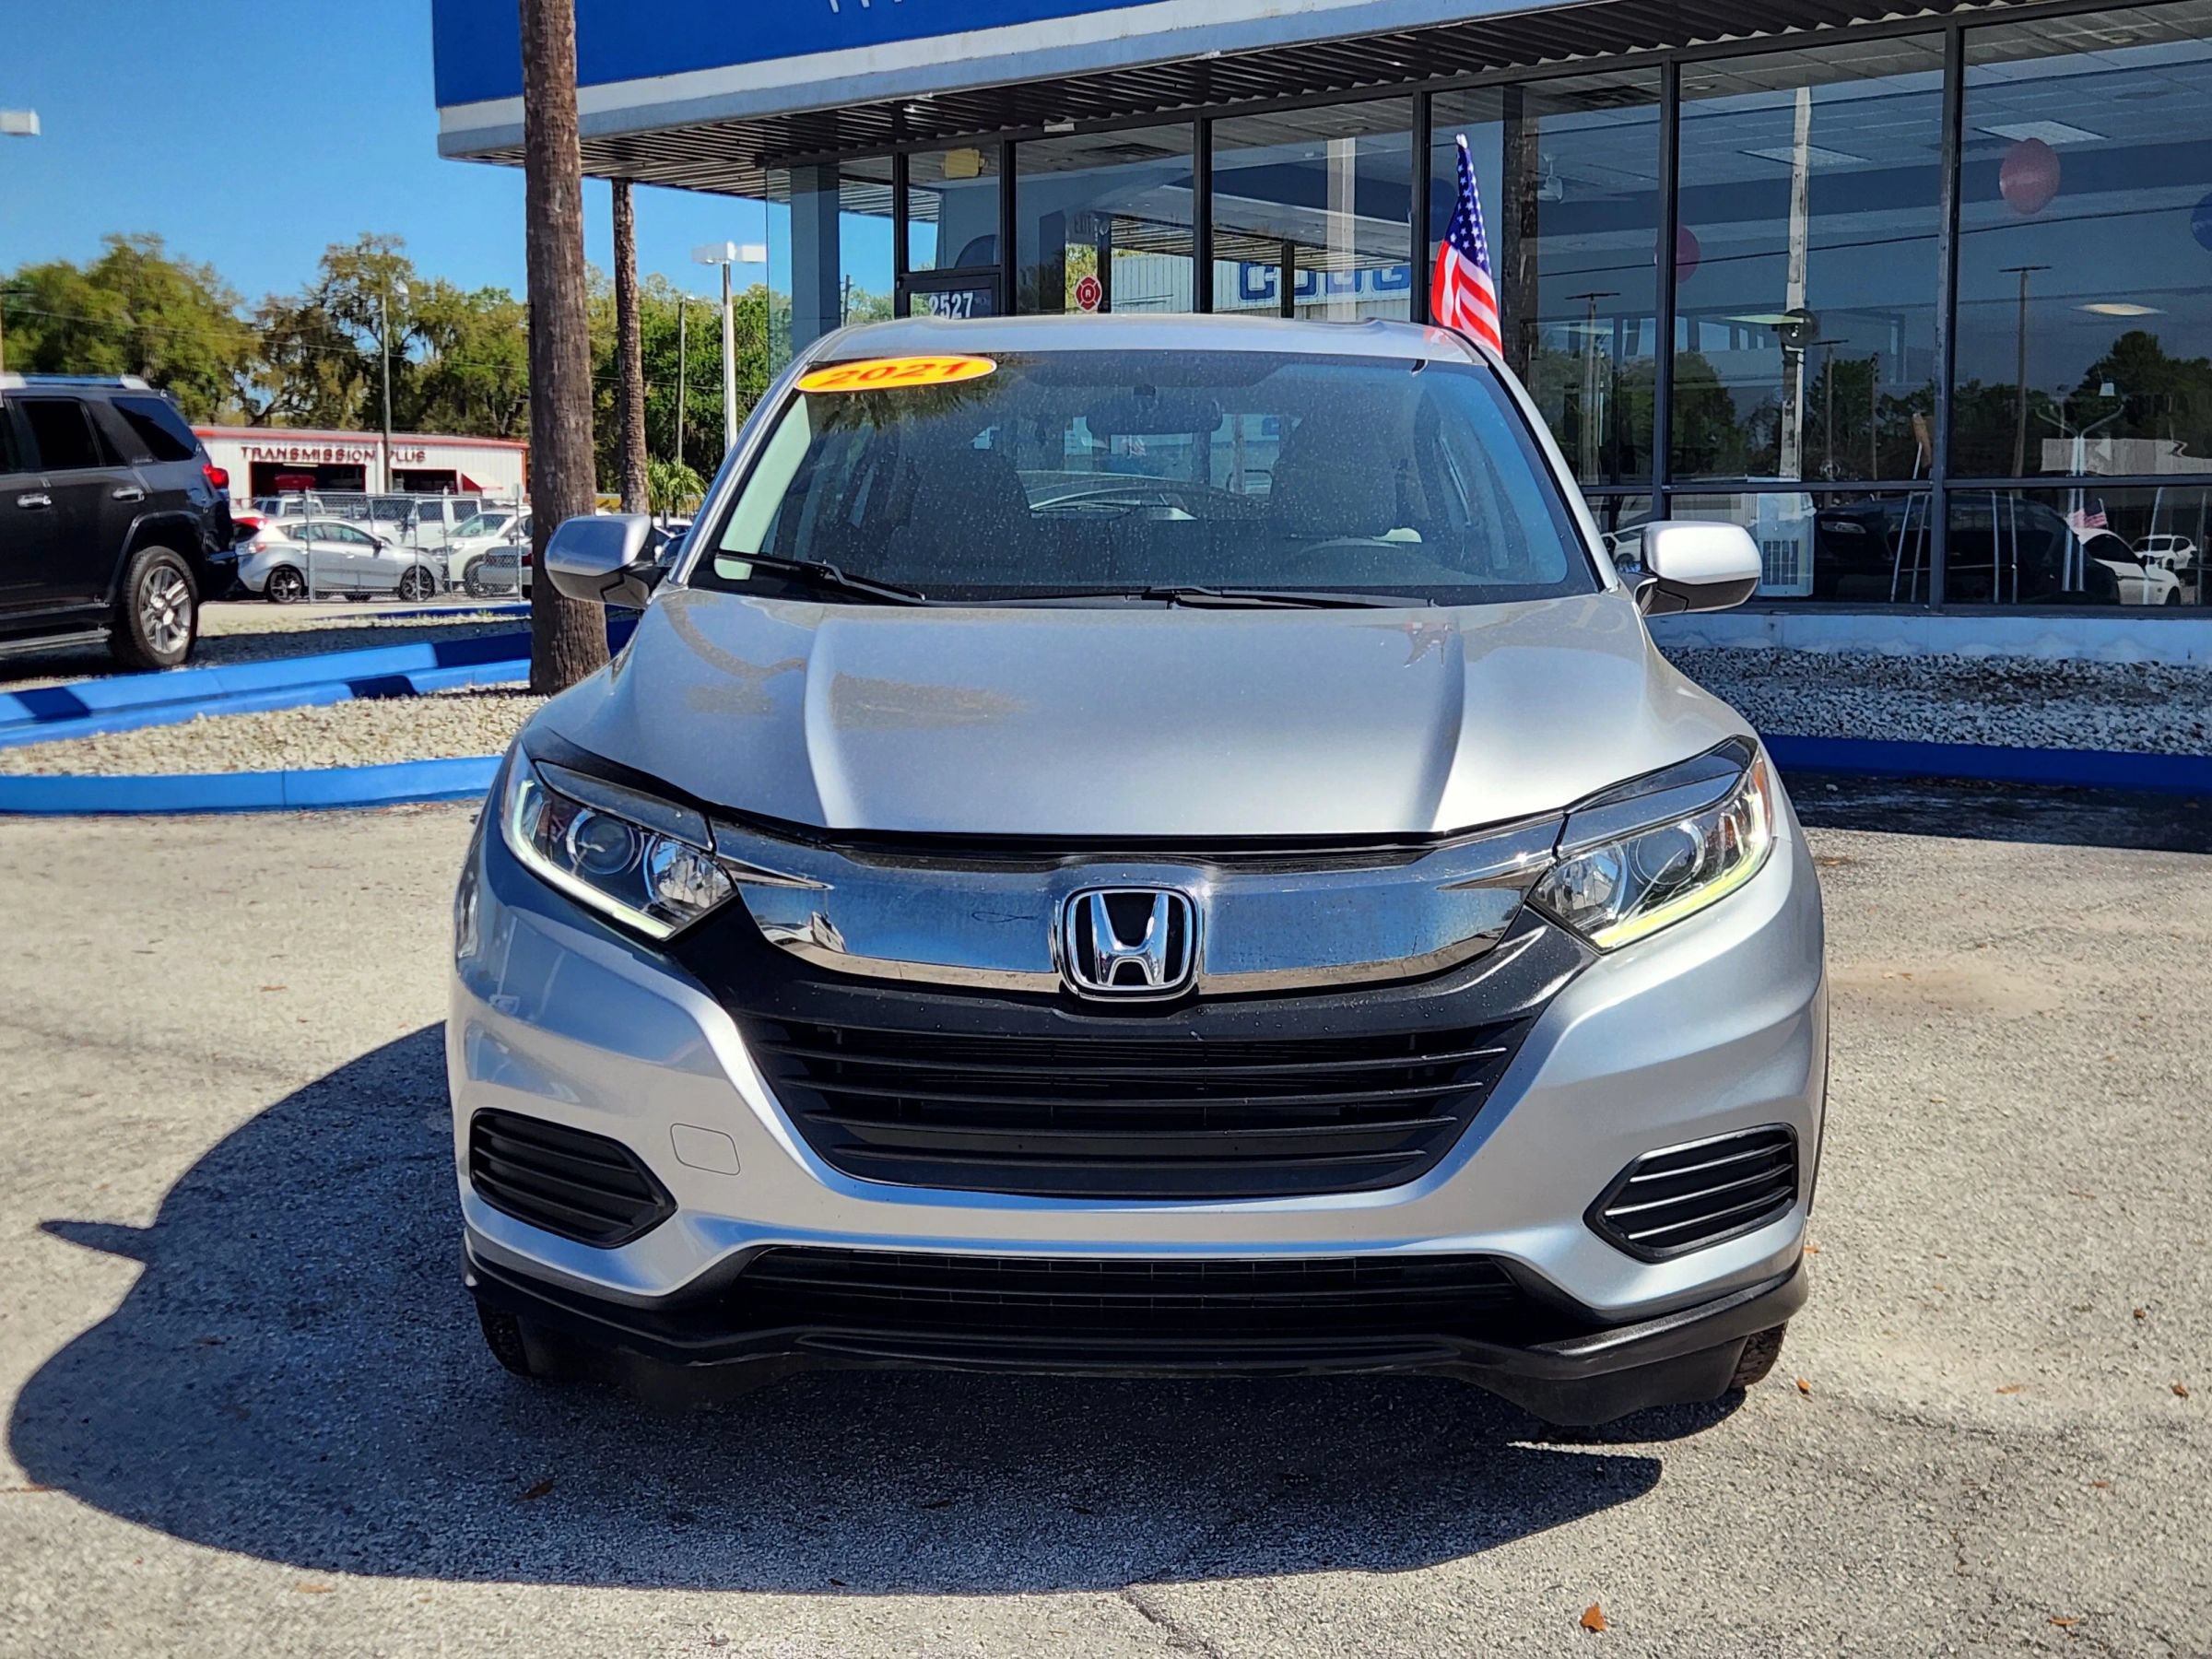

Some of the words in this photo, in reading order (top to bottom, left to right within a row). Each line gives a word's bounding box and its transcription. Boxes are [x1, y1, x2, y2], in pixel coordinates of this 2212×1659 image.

[1085, 288, 1092, 298] R
[929, 292, 973, 319] 2527
[818, 362, 969, 387] 2021
[241, 446, 376, 463] TRANSMISSION
